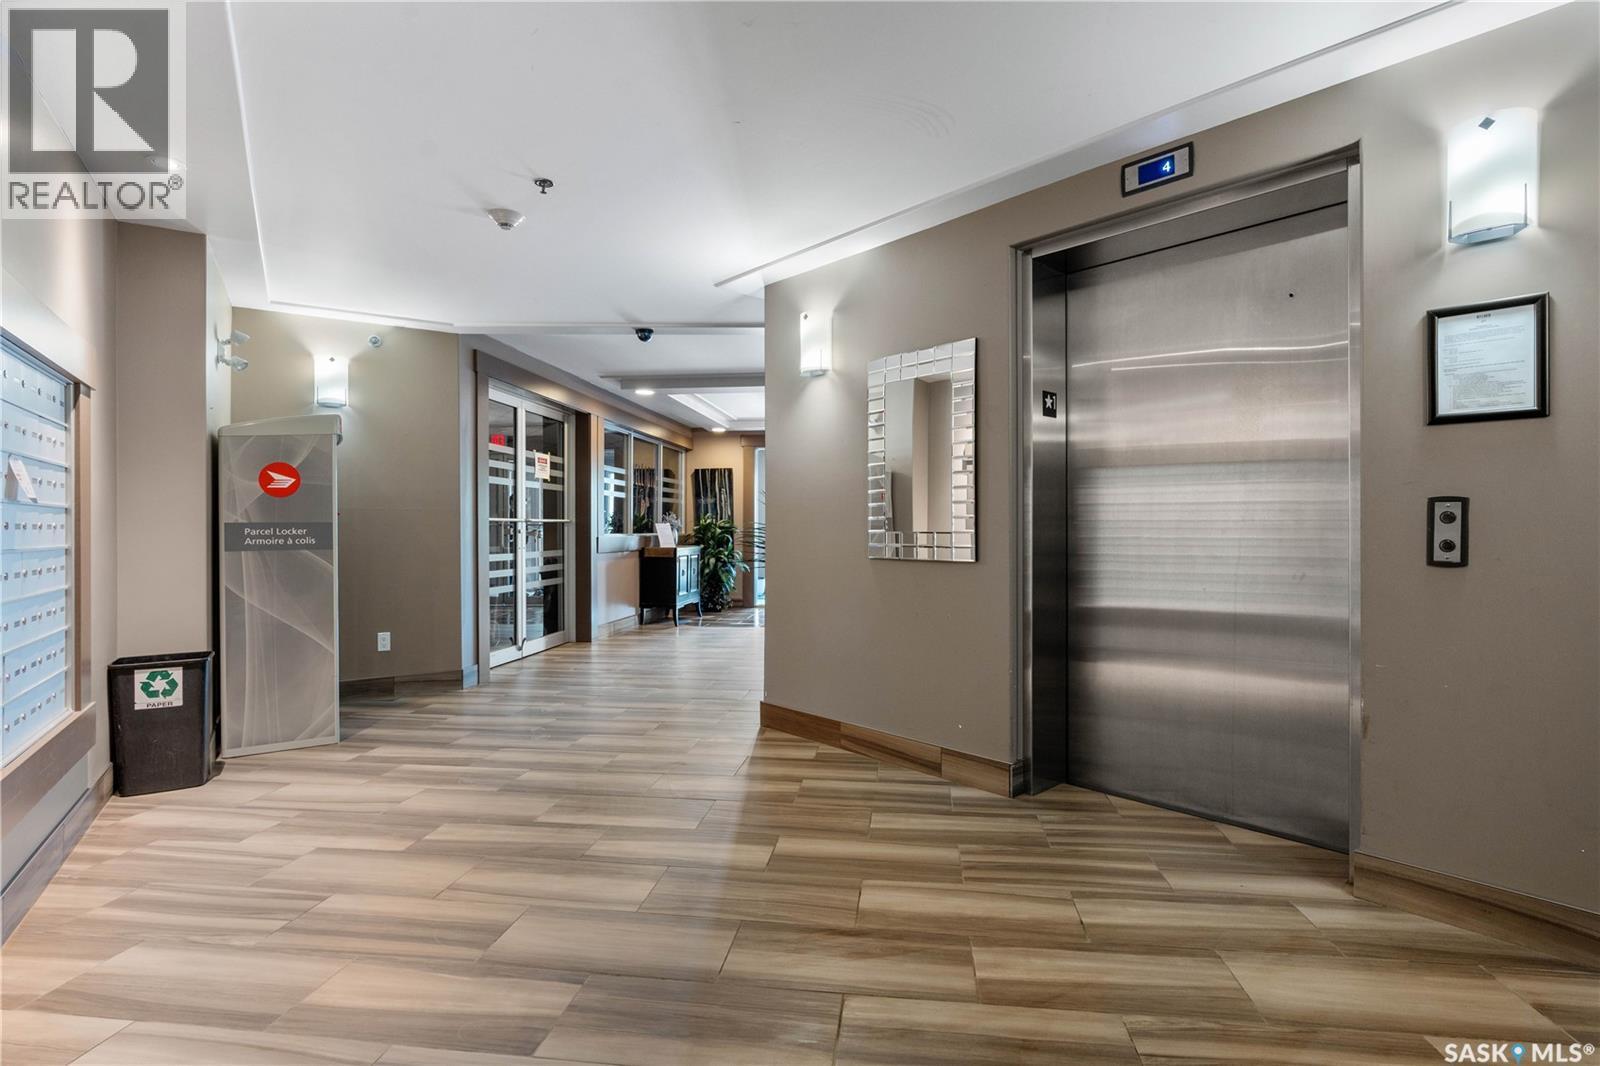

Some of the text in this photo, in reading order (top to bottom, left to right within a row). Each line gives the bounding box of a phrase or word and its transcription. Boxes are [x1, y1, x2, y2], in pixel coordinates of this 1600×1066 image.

[1162, 160, 1171, 173] 4
[244, 527, 308, 536] Parcel Locker
[244, 536, 316, 545] Armoire à colis
[146, 701, 174, 709] PAPER
